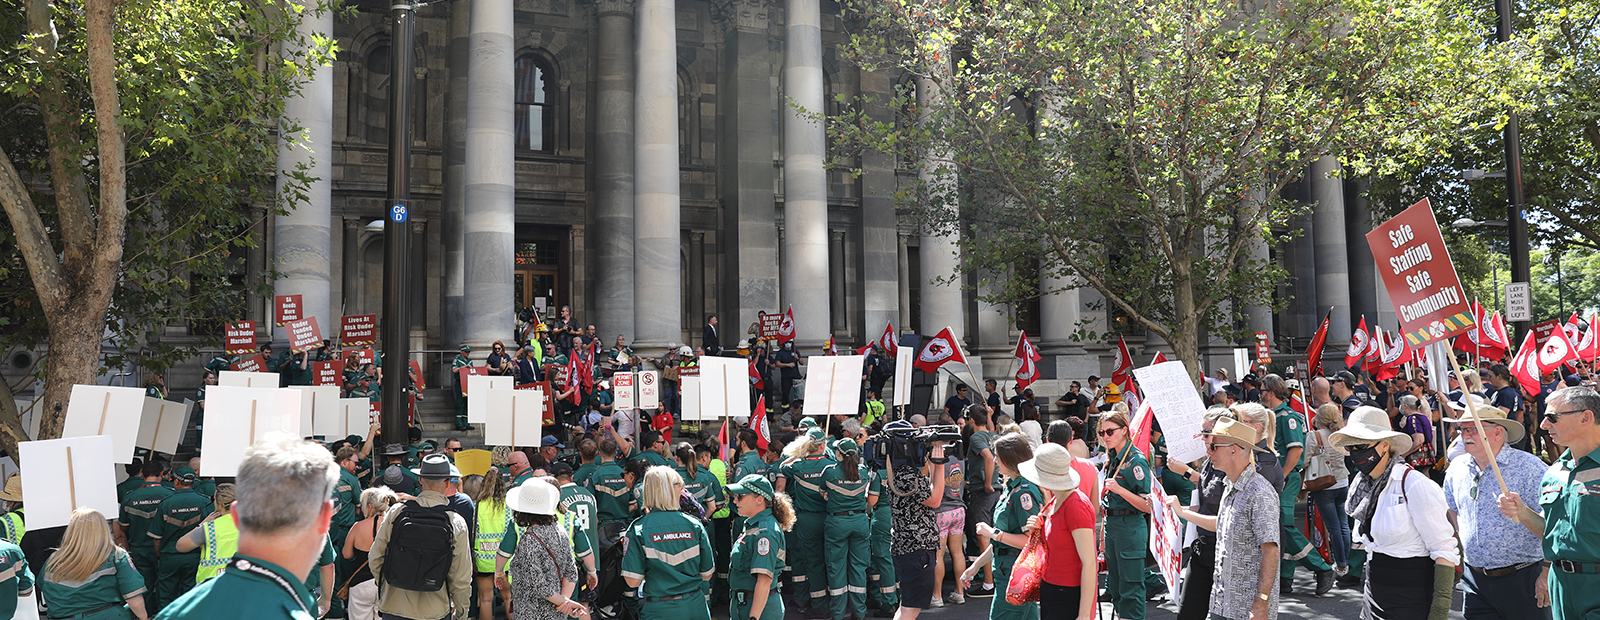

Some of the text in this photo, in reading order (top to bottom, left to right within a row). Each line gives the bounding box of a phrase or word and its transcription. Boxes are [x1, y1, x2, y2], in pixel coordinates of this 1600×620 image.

[393, 205, 406, 214] G6
[395, 213, 403, 221] D
[1388, 224, 1414, 248] Safe
[1389, 242, 1433, 275] Staffing
[1405, 270, 1432, 294] Safe
[1399, 286, 1461, 322] Community
[291, 320, 309, 329] Under
[357, 323, 374, 331] Under
[293, 325, 313, 335] Funded
[346, 330, 372, 338] Marshall
[294, 335, 319, 347] Marshall
[296, 331, 313, 341] Under
[576, 504, 590, 530] 8
[663, 532, 692, 540] AMBULANCE
